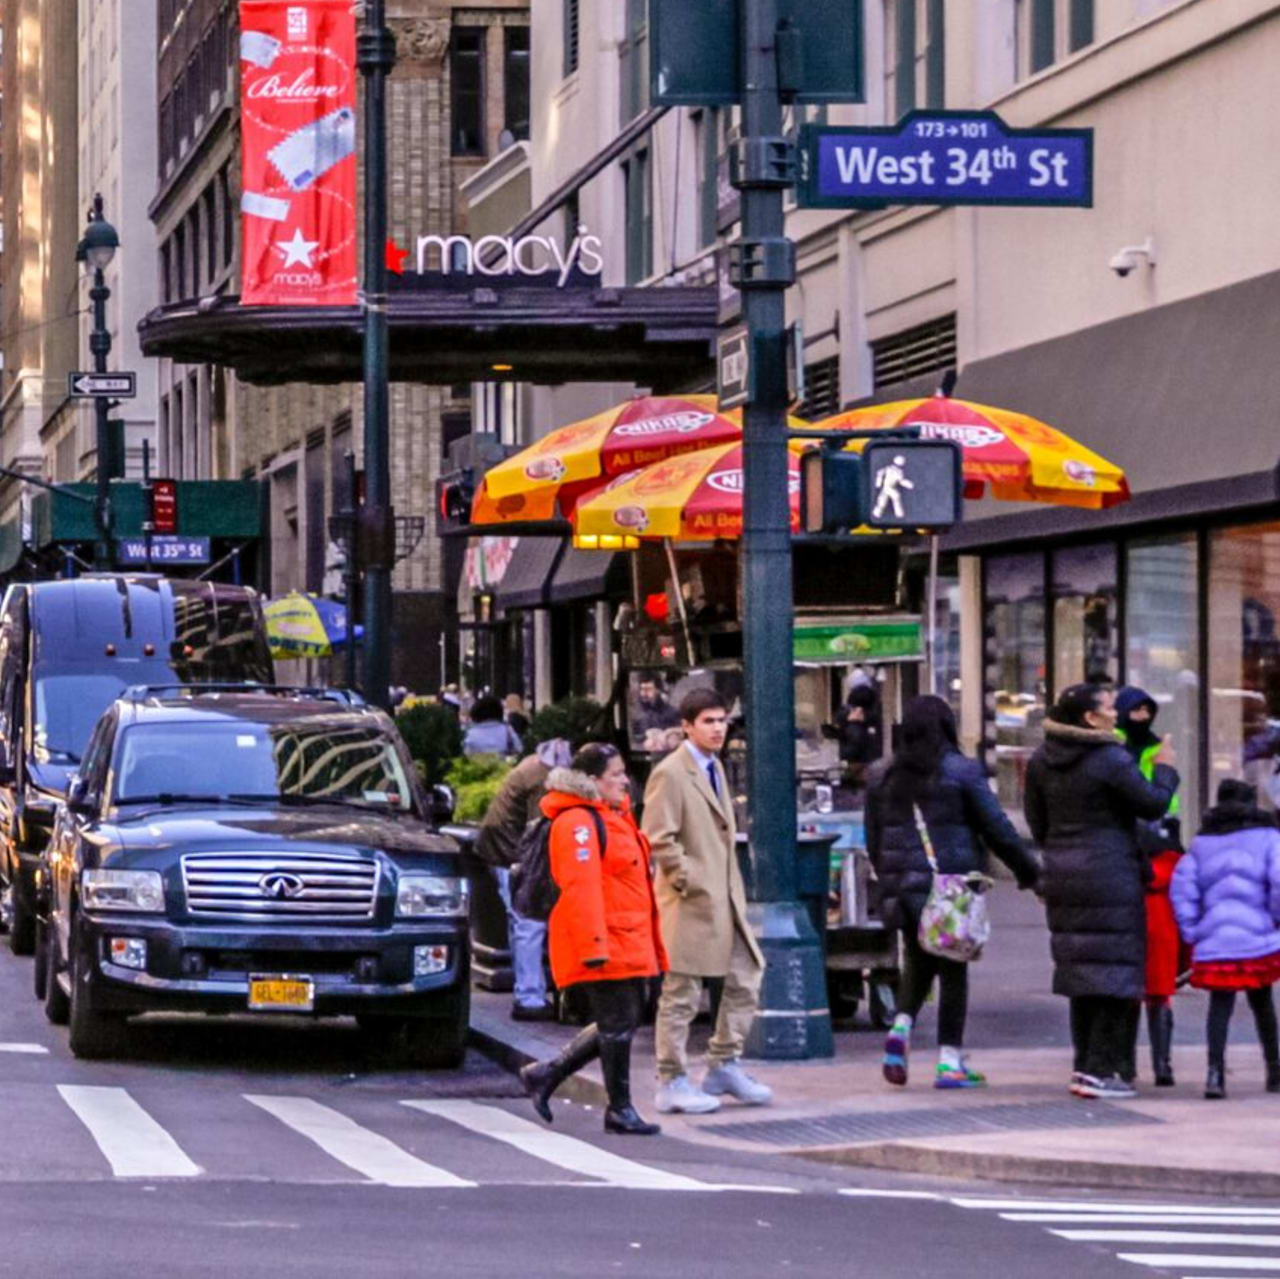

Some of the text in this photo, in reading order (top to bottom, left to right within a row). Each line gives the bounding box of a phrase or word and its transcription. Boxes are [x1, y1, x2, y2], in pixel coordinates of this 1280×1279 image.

[247, 67, 342, 99] Believe
[916, 122, 988, 138] 173 101
[835, 147, 935, 185] West
[946, 145, 1016, 185] 34th
[1029, 148, 1069, 187] St
[189, 544, 203, 558] St
